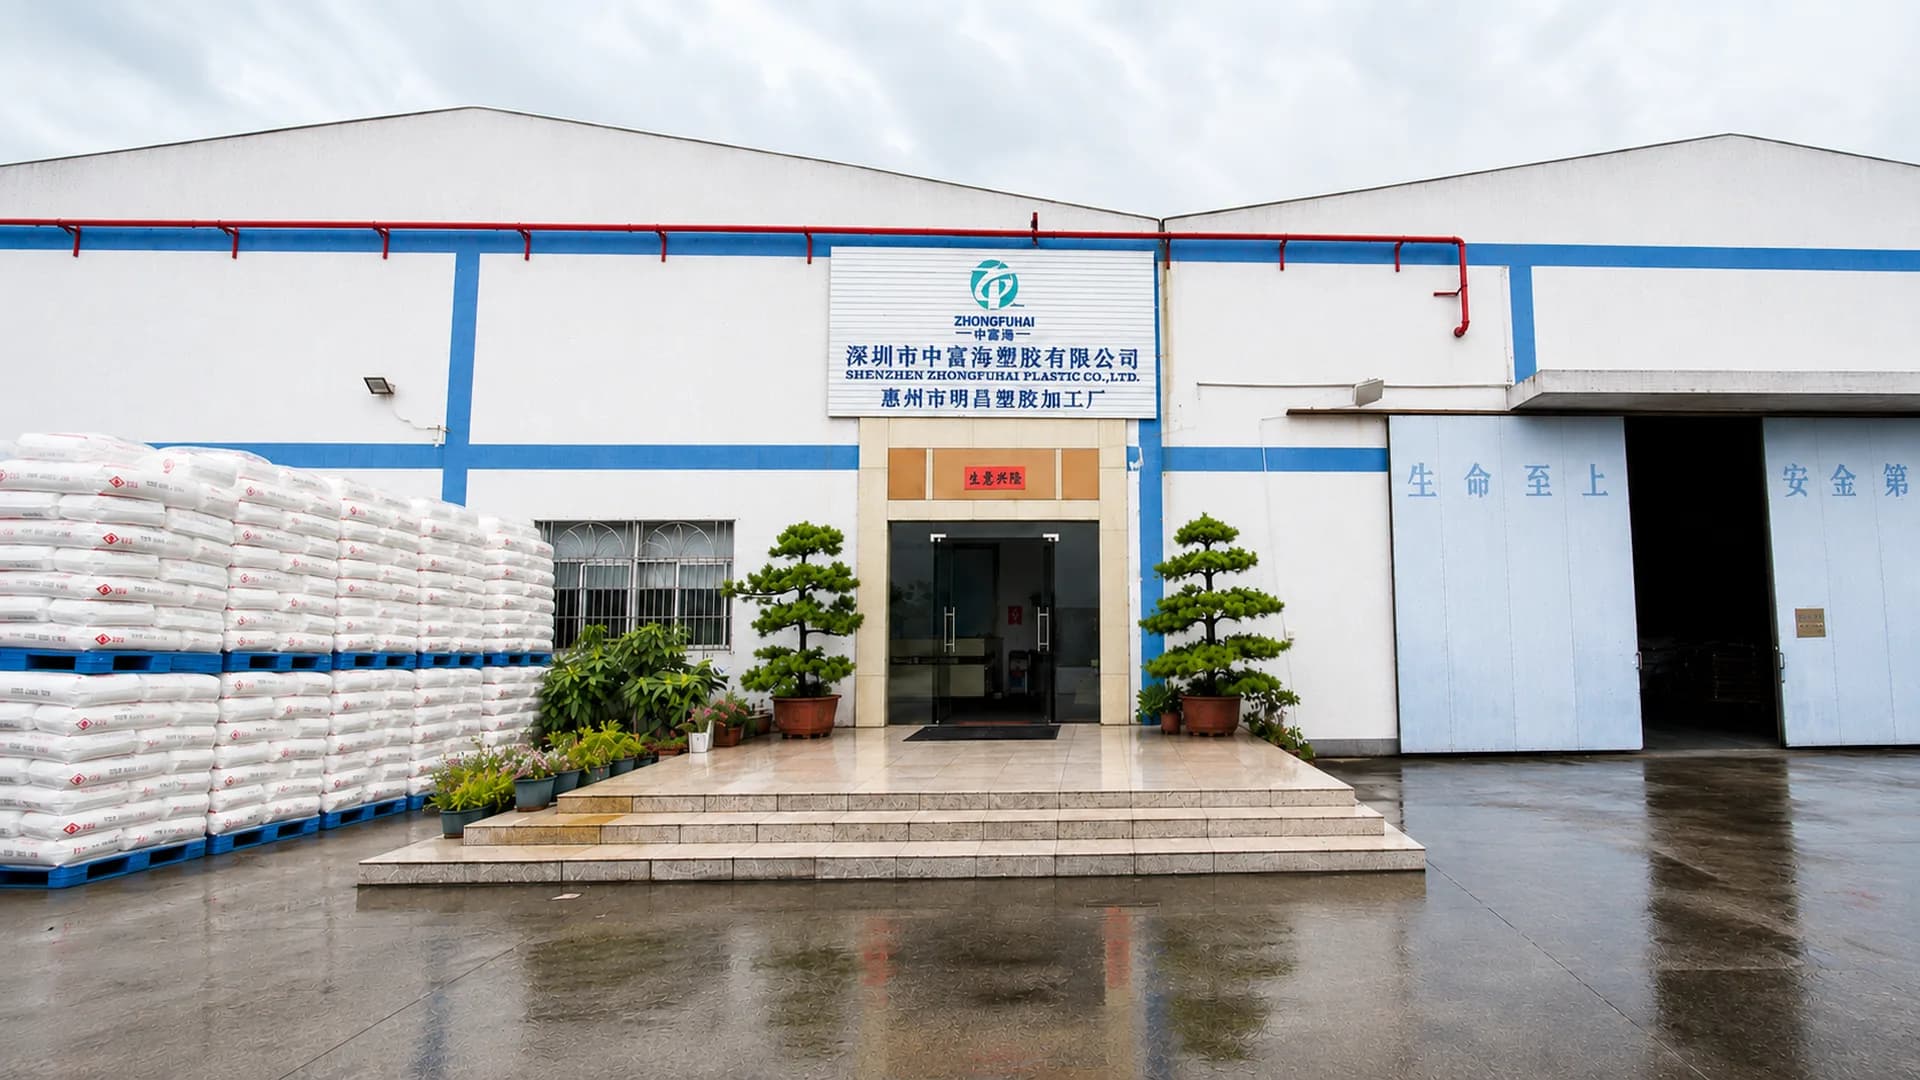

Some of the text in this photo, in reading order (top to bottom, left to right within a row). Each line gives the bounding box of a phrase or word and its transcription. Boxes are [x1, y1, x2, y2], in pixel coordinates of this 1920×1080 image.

[954, 315, 1035, 327] ZHONGFUHAI
[846, 345, 1138, 369] 深圳市中富海塑胶有限公司
[845, 370, 924, 380] SHENZHEN
[926, 370, 1020, 381] ZHONGFUHAI
[1024, 372, 1081, 381] PLASTIC
[881, 387, 1105, 409] 惠州市明昌塑胶加工厂
[1407, 462, 1609, 498] 生命至上
